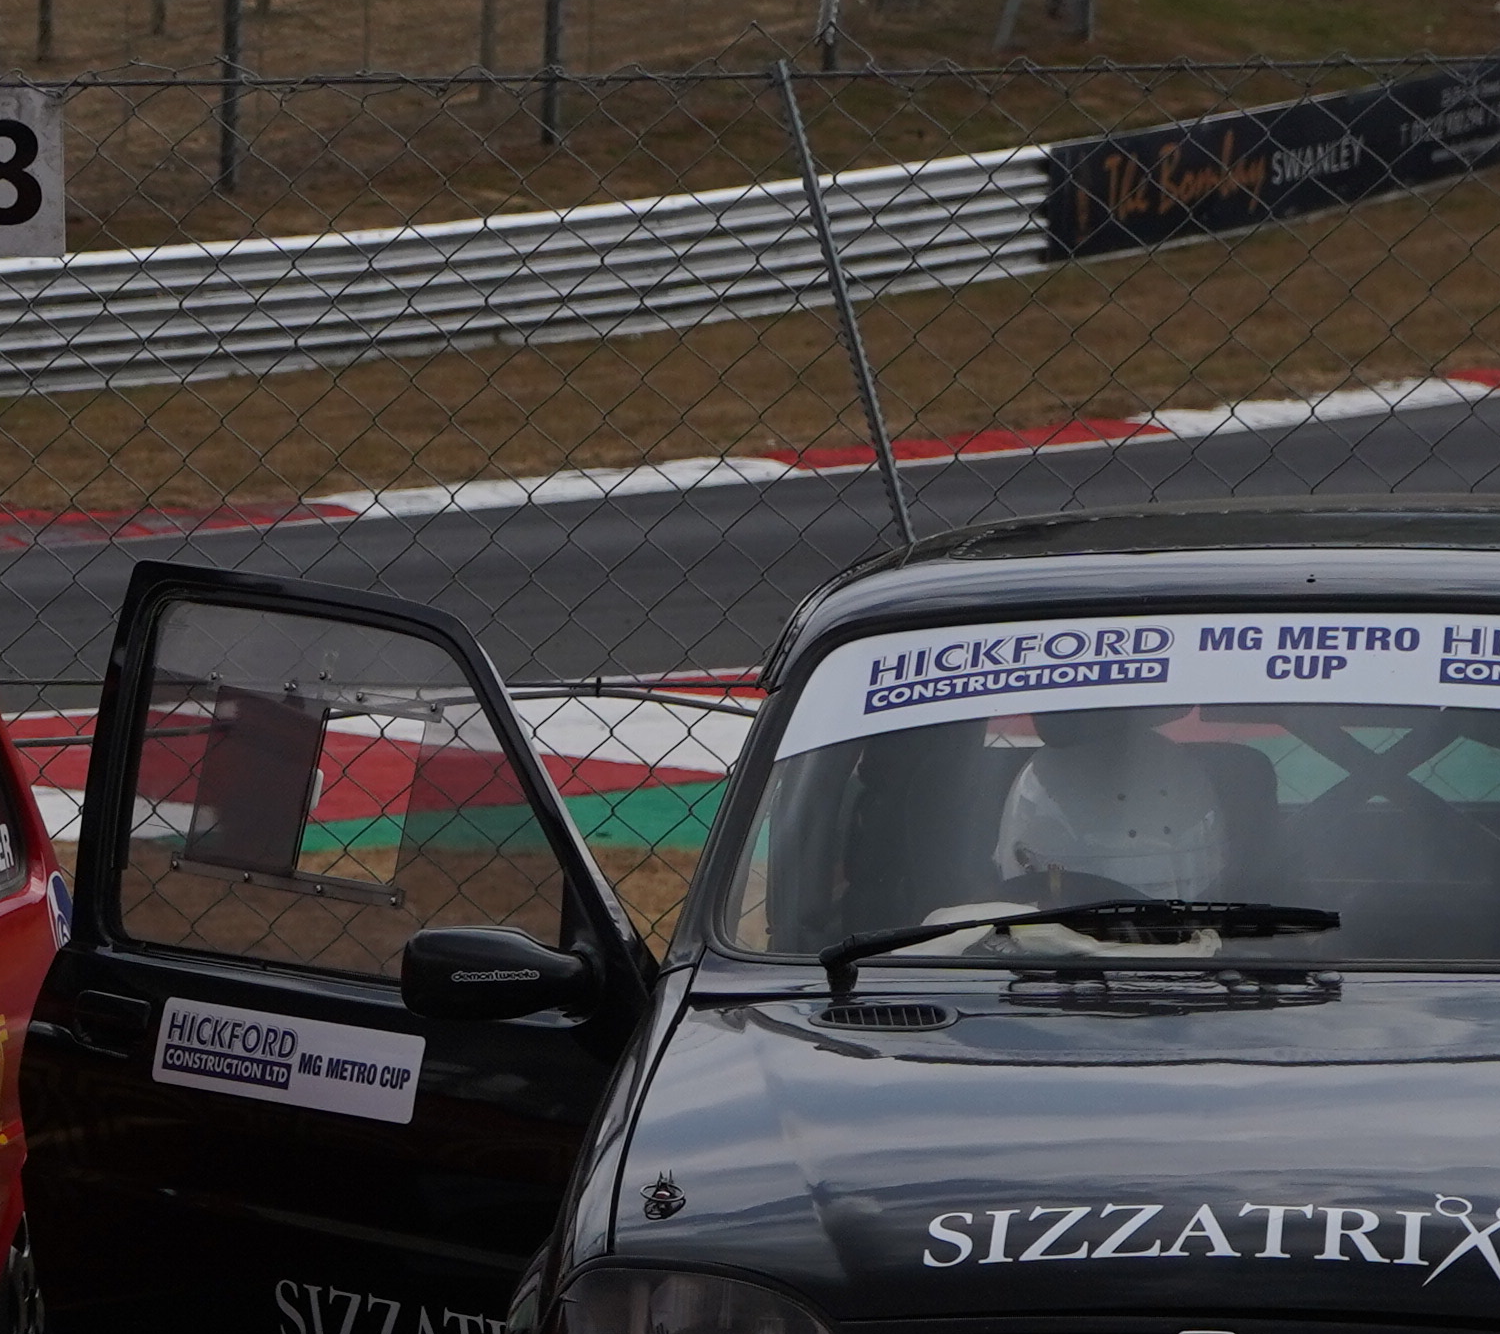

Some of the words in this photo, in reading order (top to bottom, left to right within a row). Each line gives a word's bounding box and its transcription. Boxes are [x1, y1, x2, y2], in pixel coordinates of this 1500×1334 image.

[1271, 135, 1366, 186] SWANLEY
[869, 625, 1175, 687] HICKFORD
[1199, 627, 1262, 652] MG
[1278, 627, 1420, 652] METRO
[871, 666, 1098, 709] CONSTRUCTION
[1110, 659, 1163, 681] LTD
[1265, 655, 1348, 680] CUP
[167, 1010, 298, 1060] HICKFORD
[164, 1048, 262, 1080] CONSTRUCTION
[264, 1065, 289, 1084] LTD
[298, 1053, 322, 1075] MG
[325, 1058, 377, 1085] METRO
[379, 1066, 411, 1090] CUP
